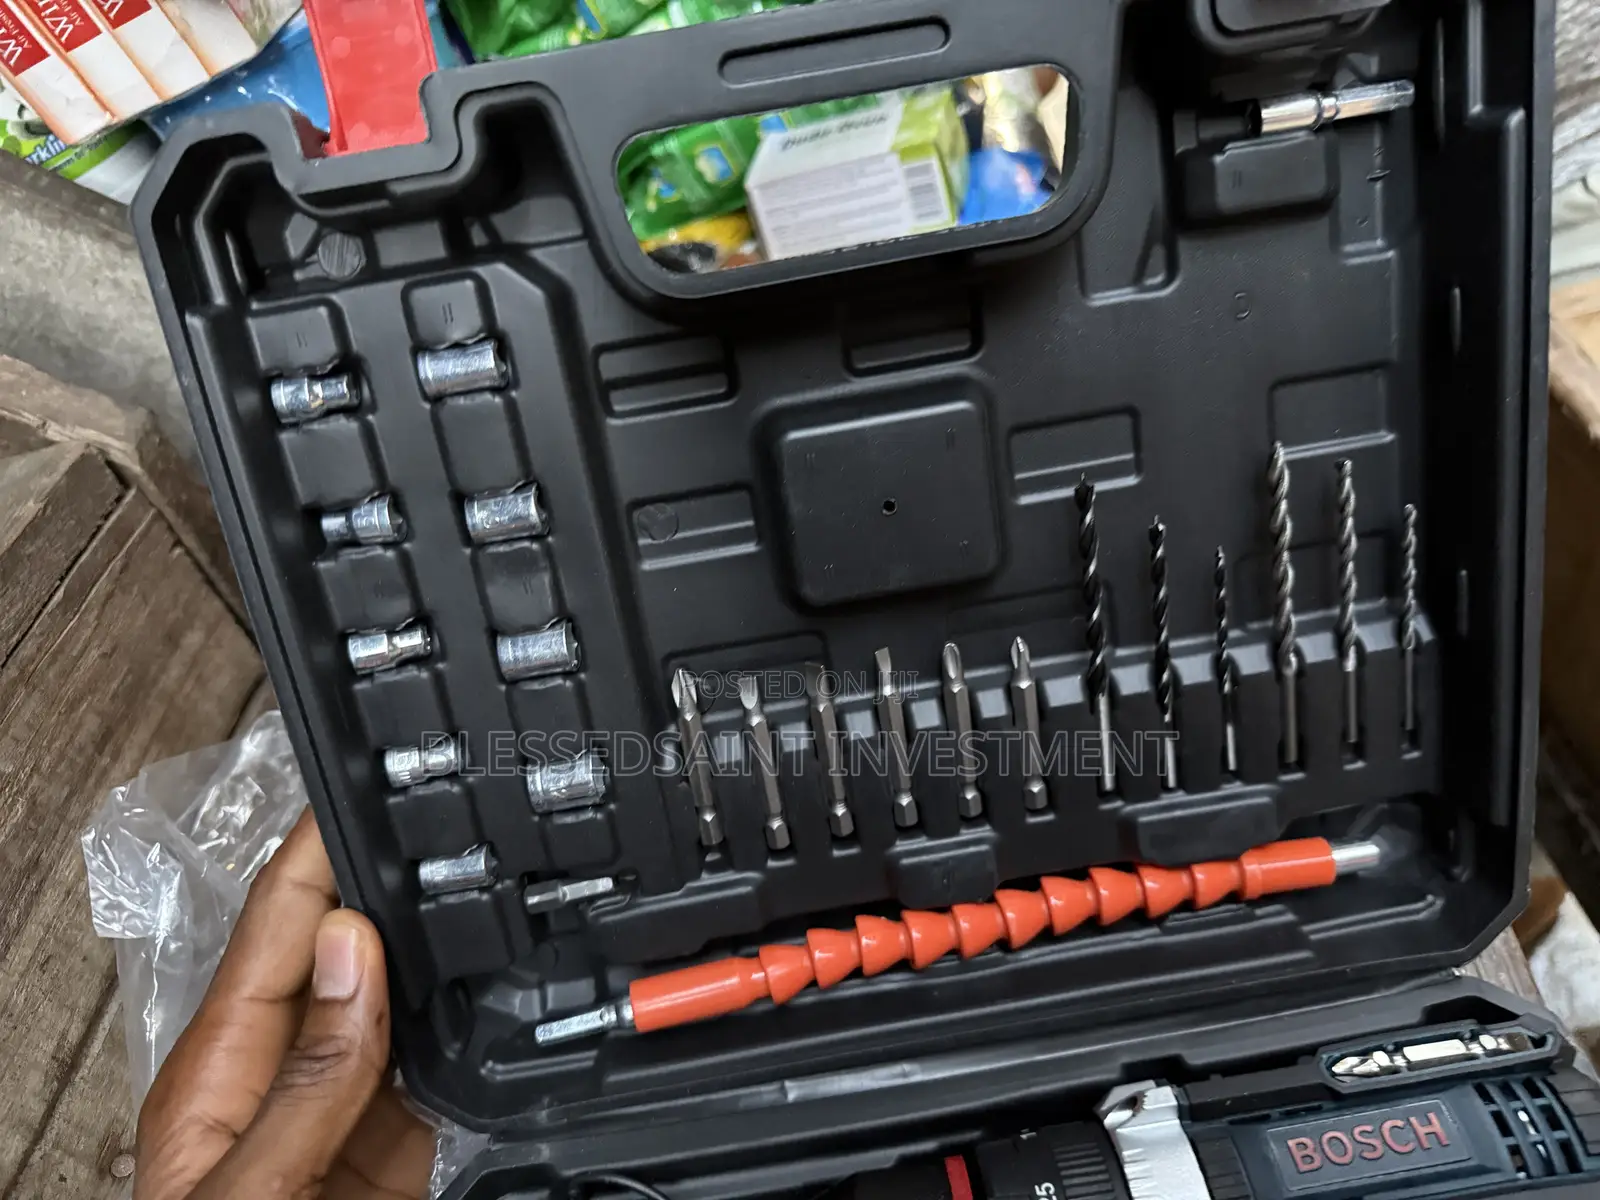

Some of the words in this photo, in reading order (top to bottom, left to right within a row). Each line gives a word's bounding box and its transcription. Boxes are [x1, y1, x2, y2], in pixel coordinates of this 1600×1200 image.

[70, 12, 85, 26] Air
[18, 35, 32, 48] Air
[1286, 1111, 1452, 1174] BOSCH
